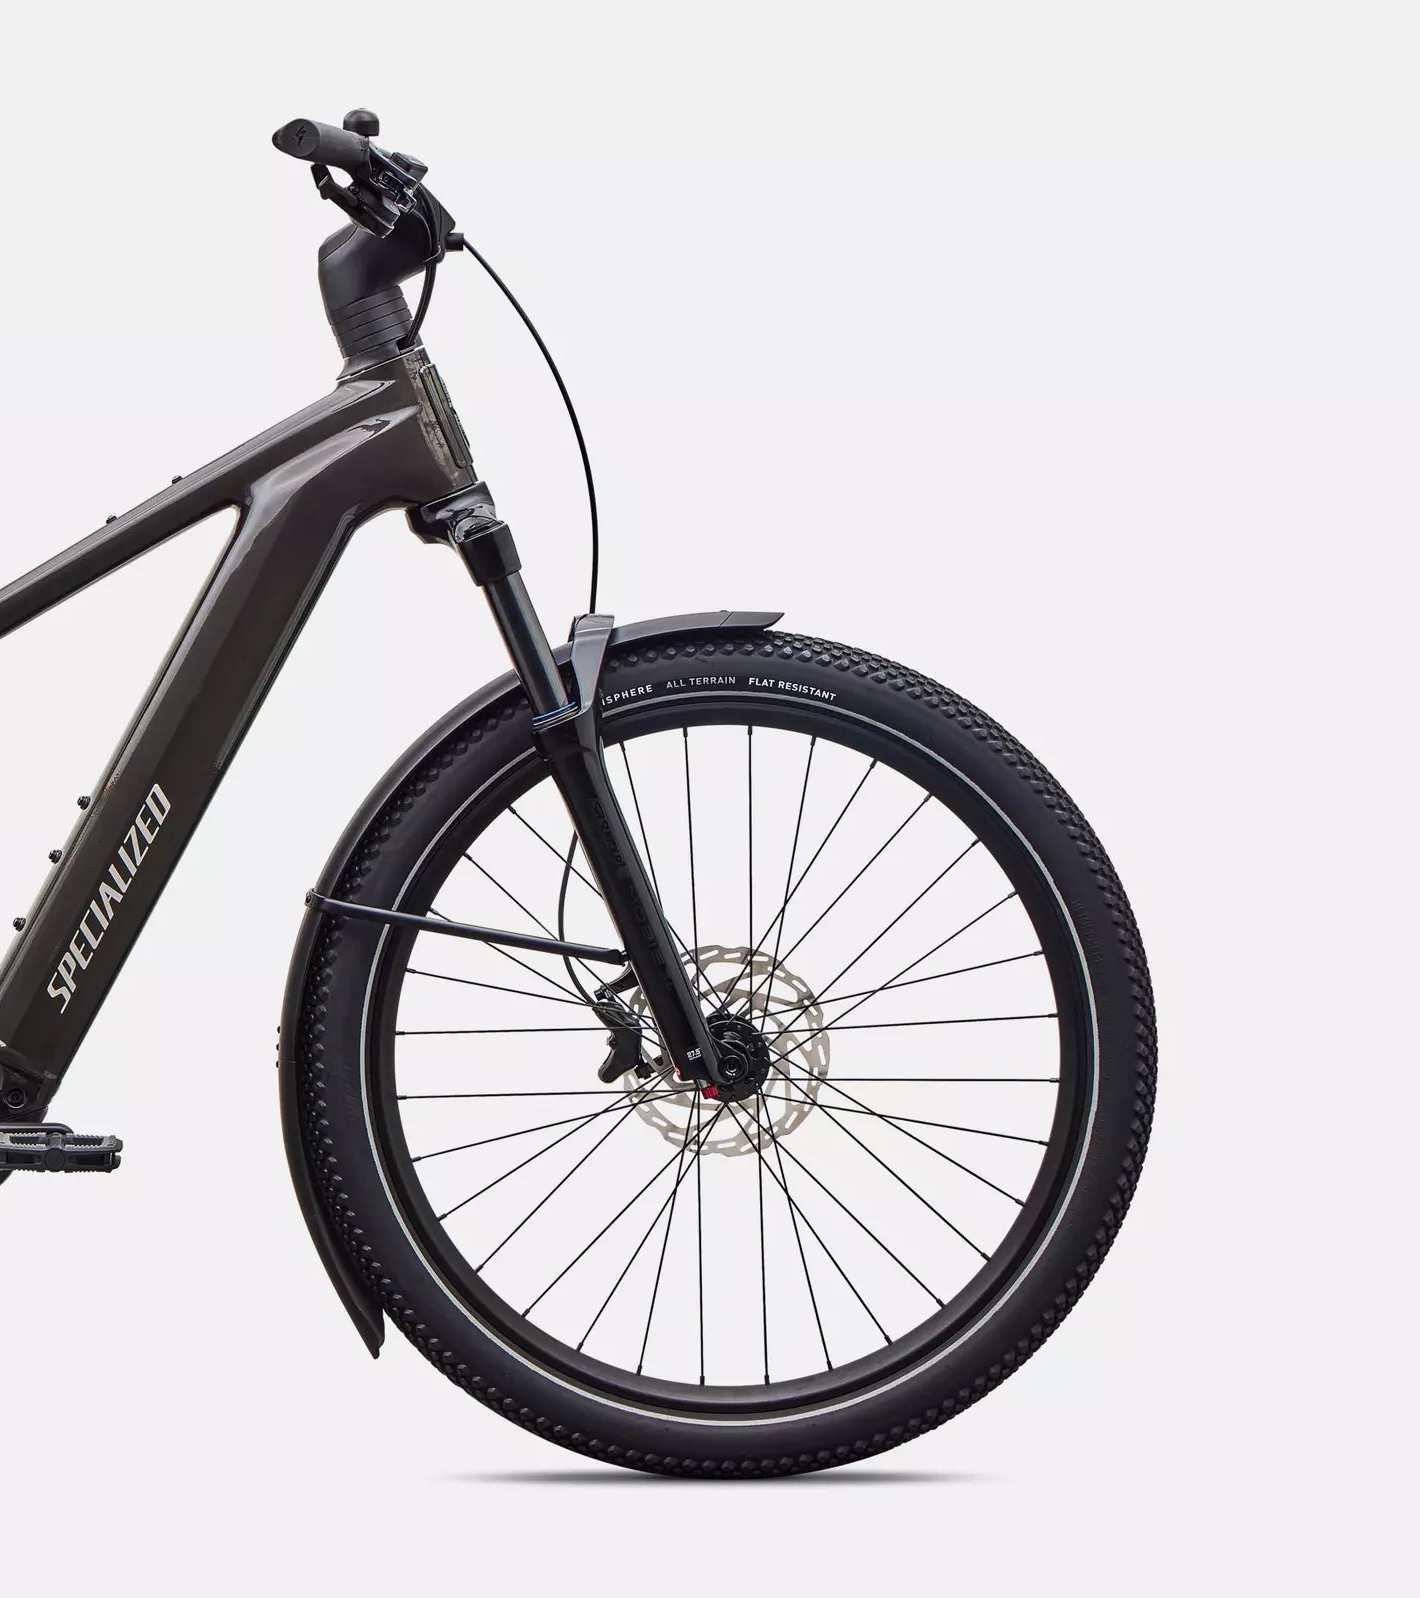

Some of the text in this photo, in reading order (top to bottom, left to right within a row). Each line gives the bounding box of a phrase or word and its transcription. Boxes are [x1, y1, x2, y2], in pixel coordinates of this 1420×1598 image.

[666, 676, 736, 689] ALL TERRAIN
[748, 677, 837, 701] FLAT RESISTANT
[601, 684, 653, 706] ISPHERE
[46, 783, 172, 1015] SPECIALIZED
